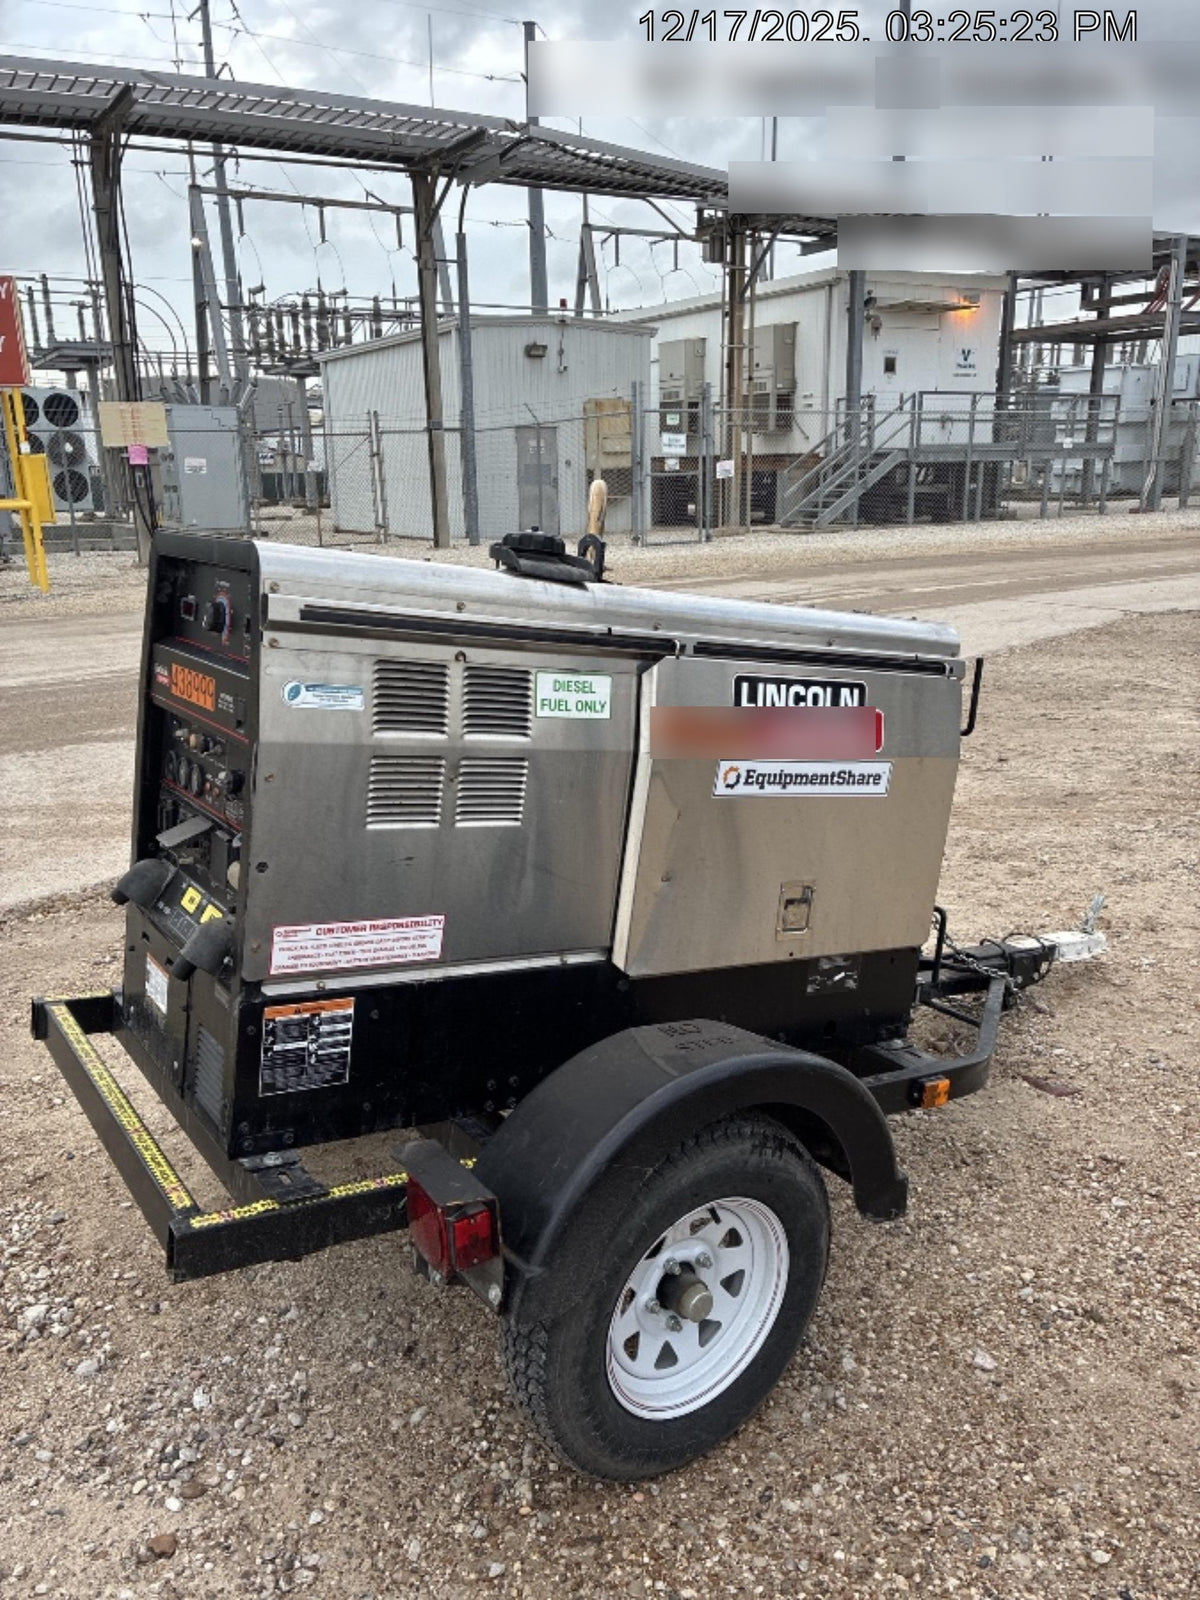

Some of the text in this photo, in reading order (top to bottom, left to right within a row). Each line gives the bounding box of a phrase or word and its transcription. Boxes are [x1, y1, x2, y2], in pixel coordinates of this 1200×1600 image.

[171, 664, 215, 707] 438999
[553, 679, 596, 694] DIESEL
[740, 682, 860, 707] LINCOLN
[540, 698, 607, 713] FUEL ONLY
[743, 769, 882, 790] EquipmentShare
